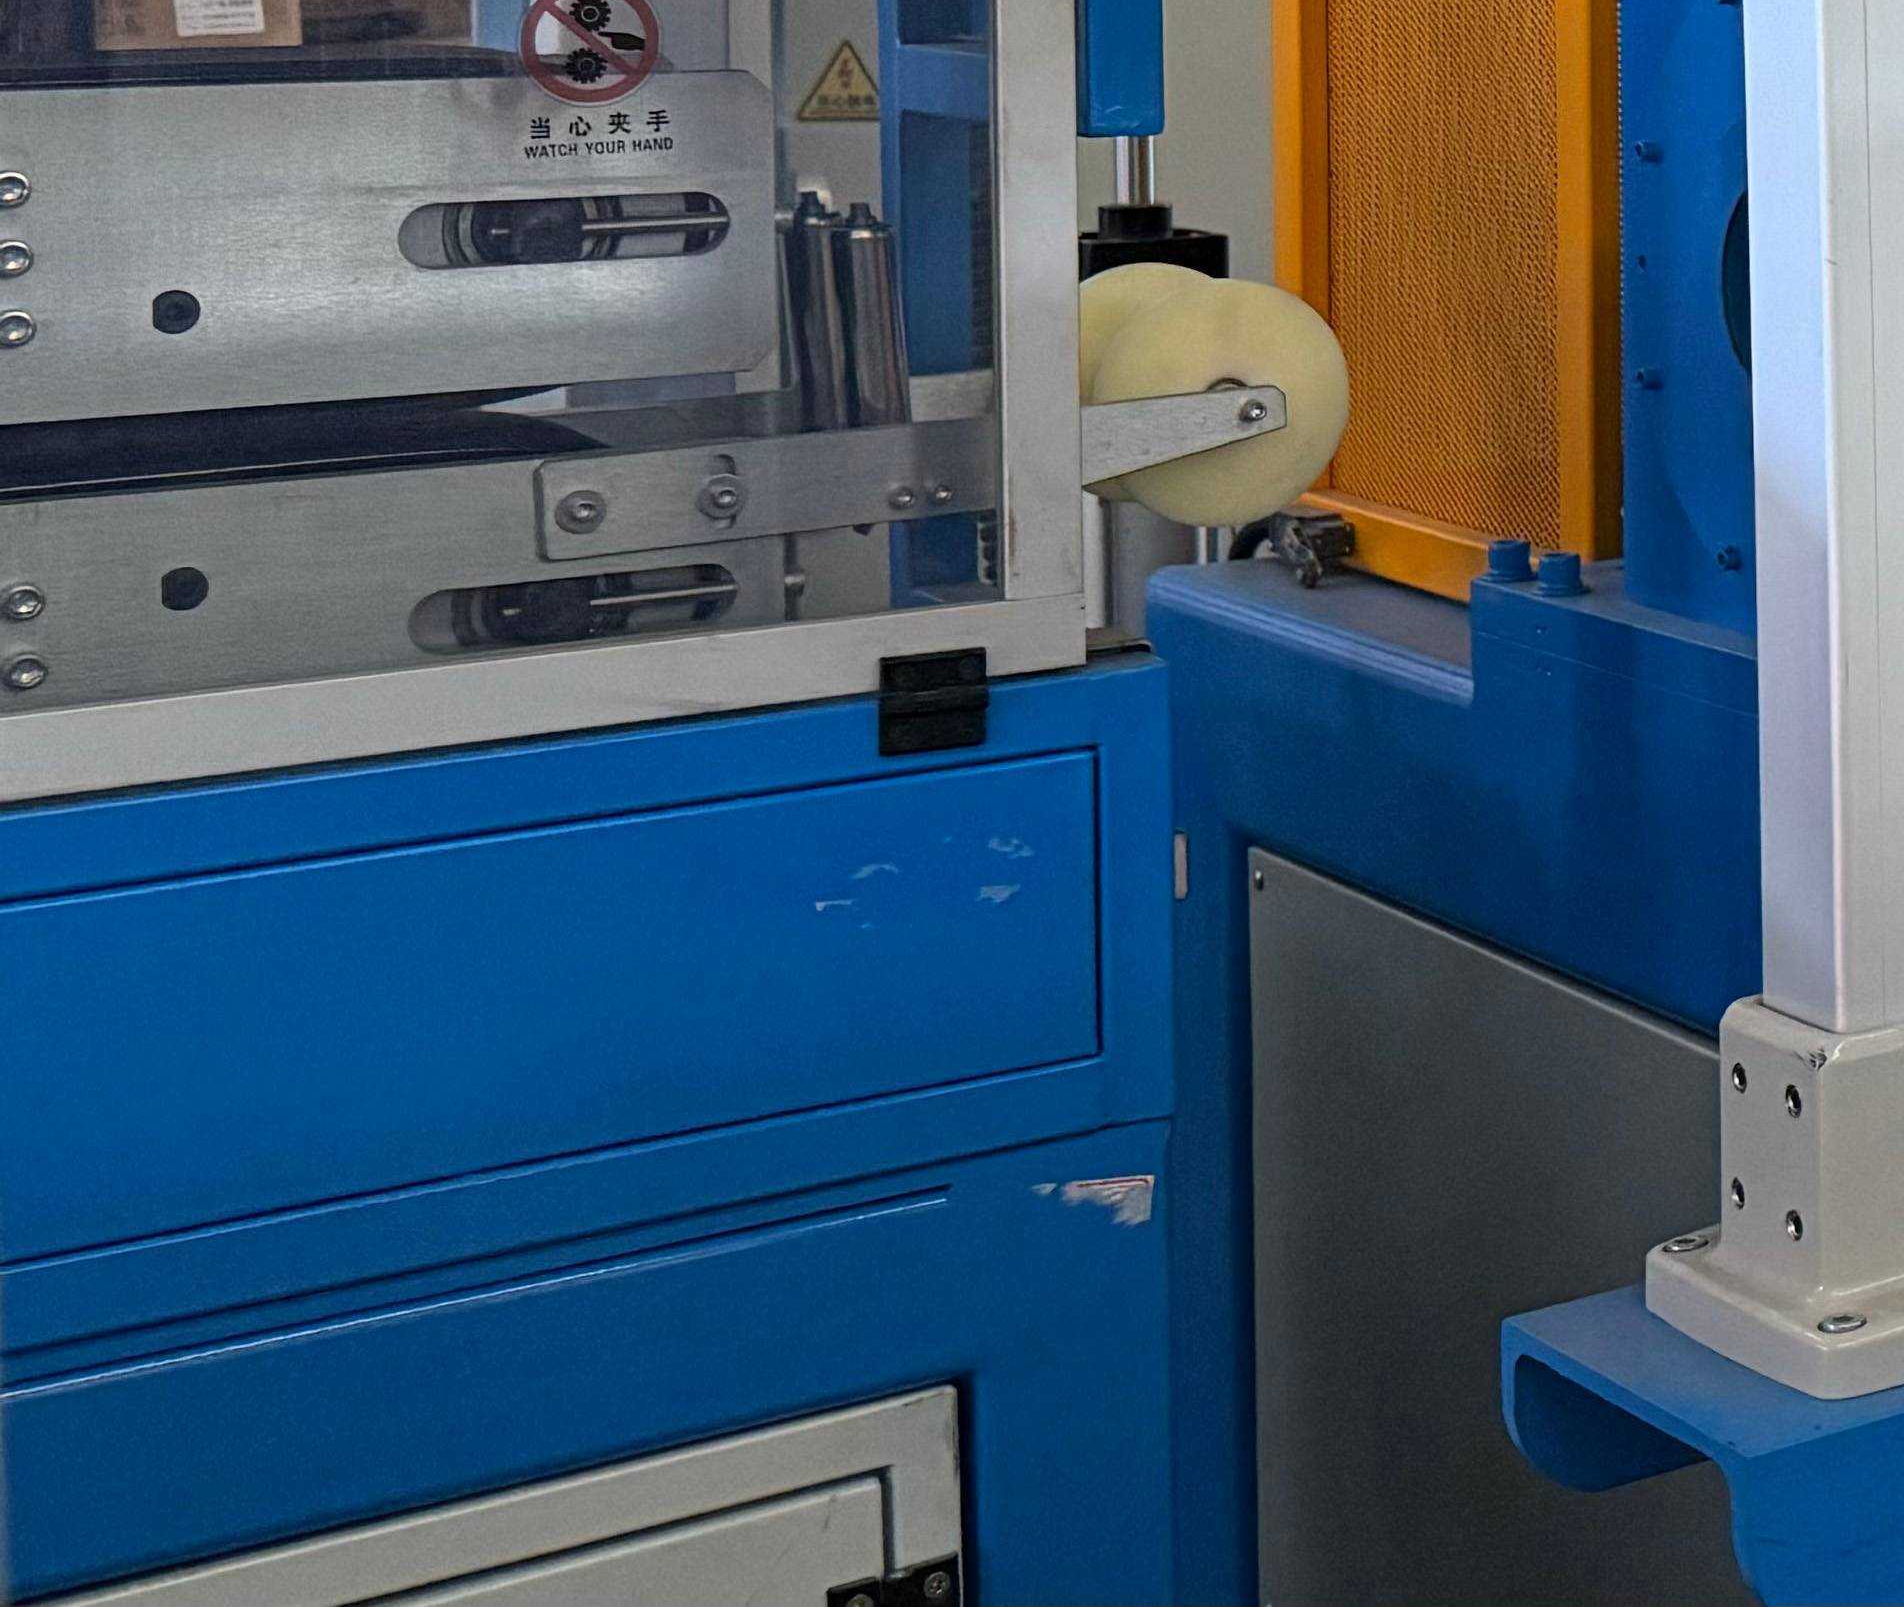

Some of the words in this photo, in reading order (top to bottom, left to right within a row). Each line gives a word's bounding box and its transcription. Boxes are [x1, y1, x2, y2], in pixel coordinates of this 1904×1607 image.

[530, 109, 671, 140] 当心夹手
[524, 144, 578, 159] WATCH
[585, 139, 627, 155] YOUR
[632, 137, 674, 152] HAND
